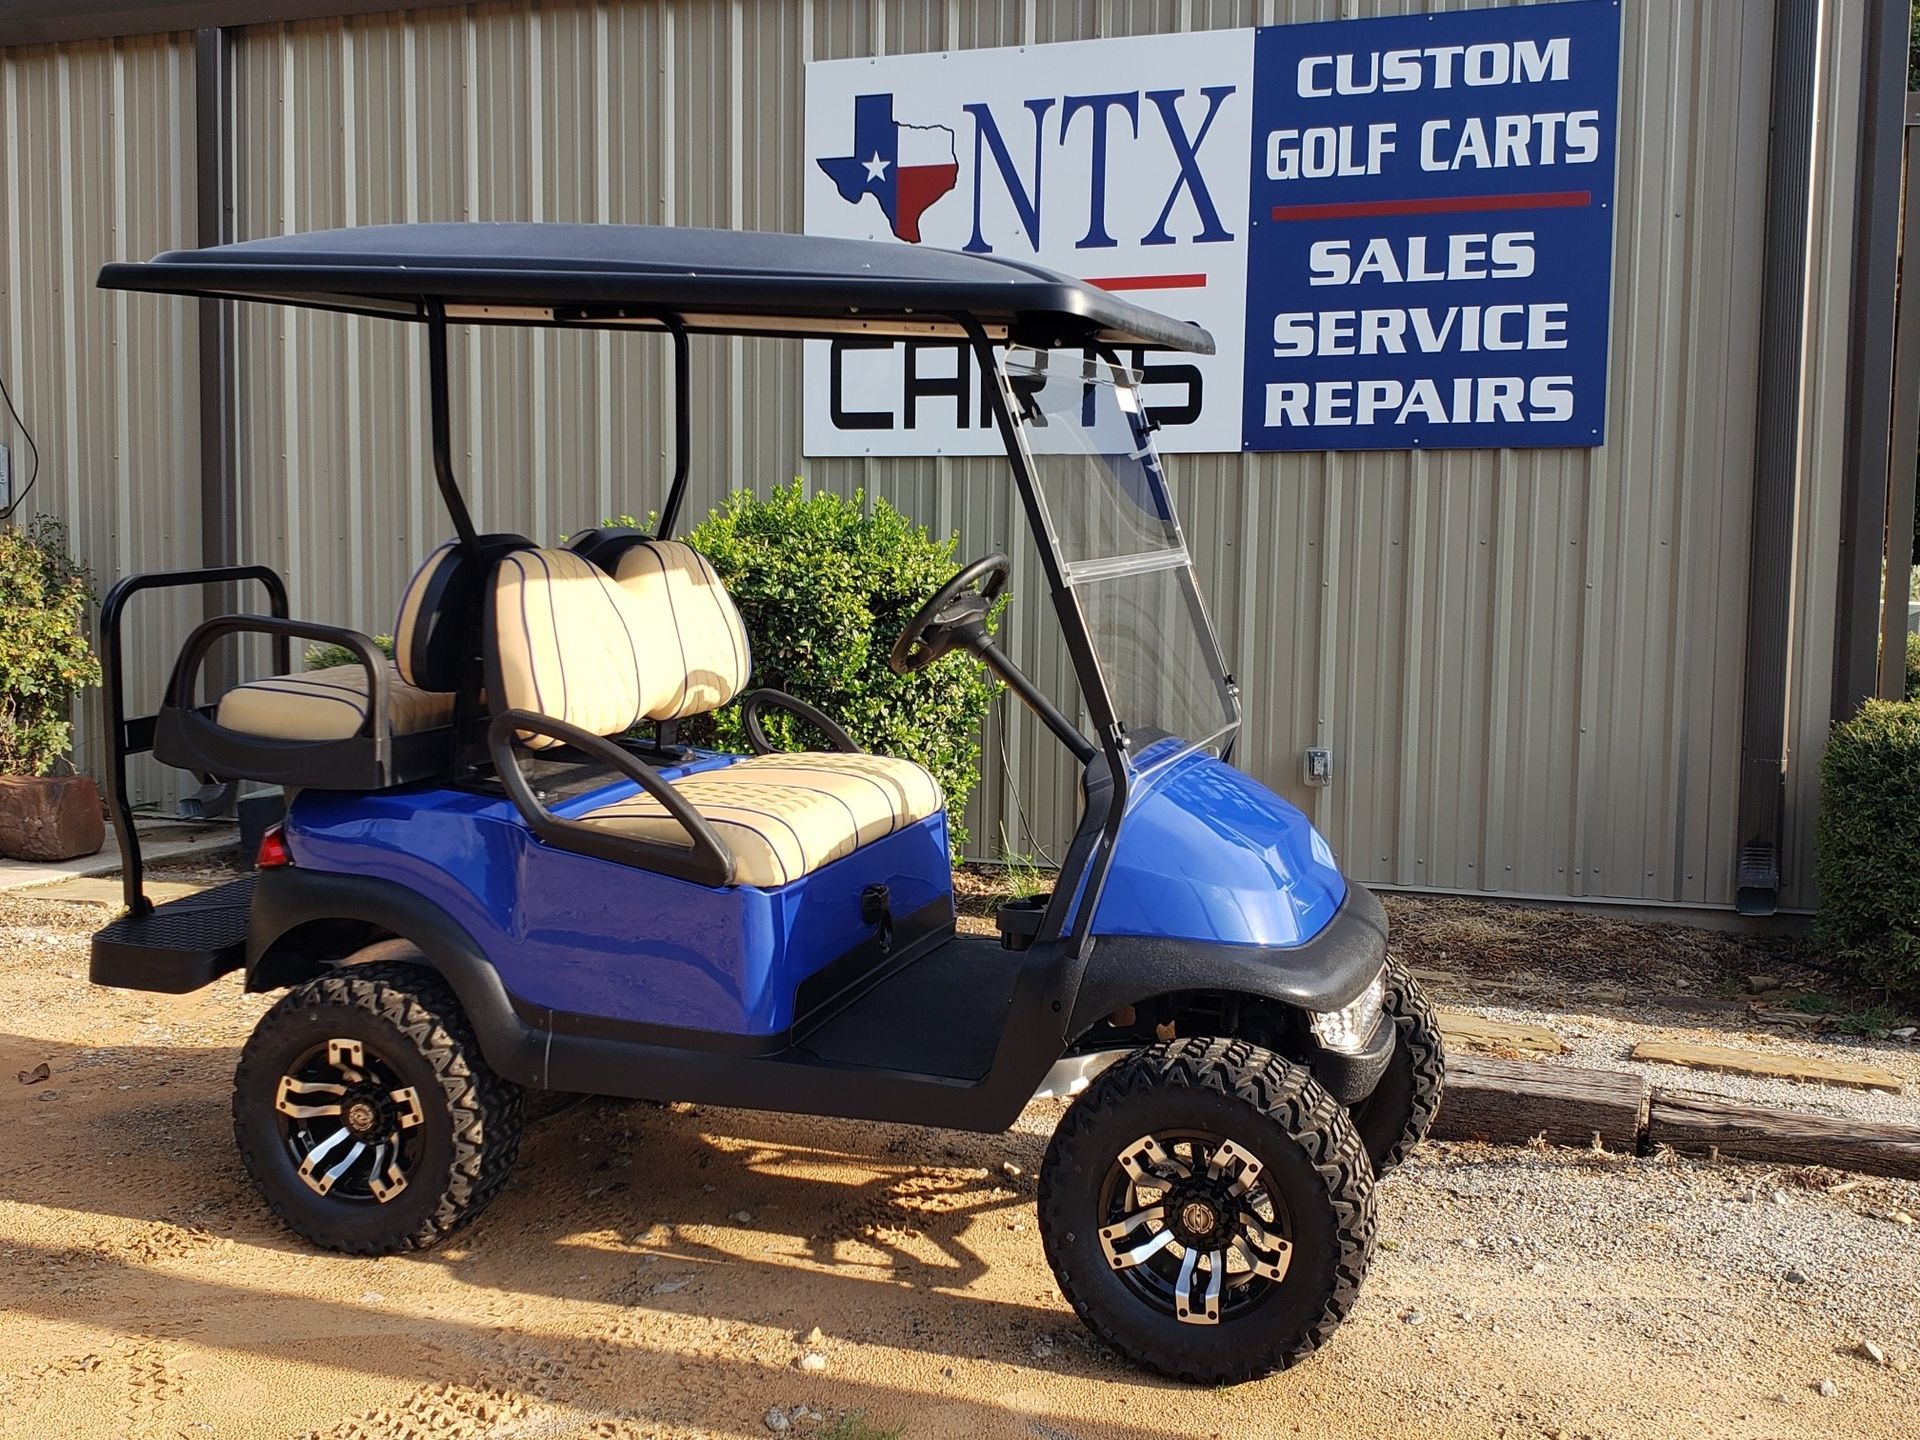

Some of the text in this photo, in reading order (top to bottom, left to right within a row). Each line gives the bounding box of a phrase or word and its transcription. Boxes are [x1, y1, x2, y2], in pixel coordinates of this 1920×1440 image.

[1297, 37, 1571, 98] CUSTOM
[962, 86, 1237, 253] NTX
[1266, 110, 1599, 180] GOLF CARTS
[1309, 231, 1535, 286] SALES
[1273, 302, 1569, 358] SERVICE
[1263, 375, 1574, 427] REPAIRS
